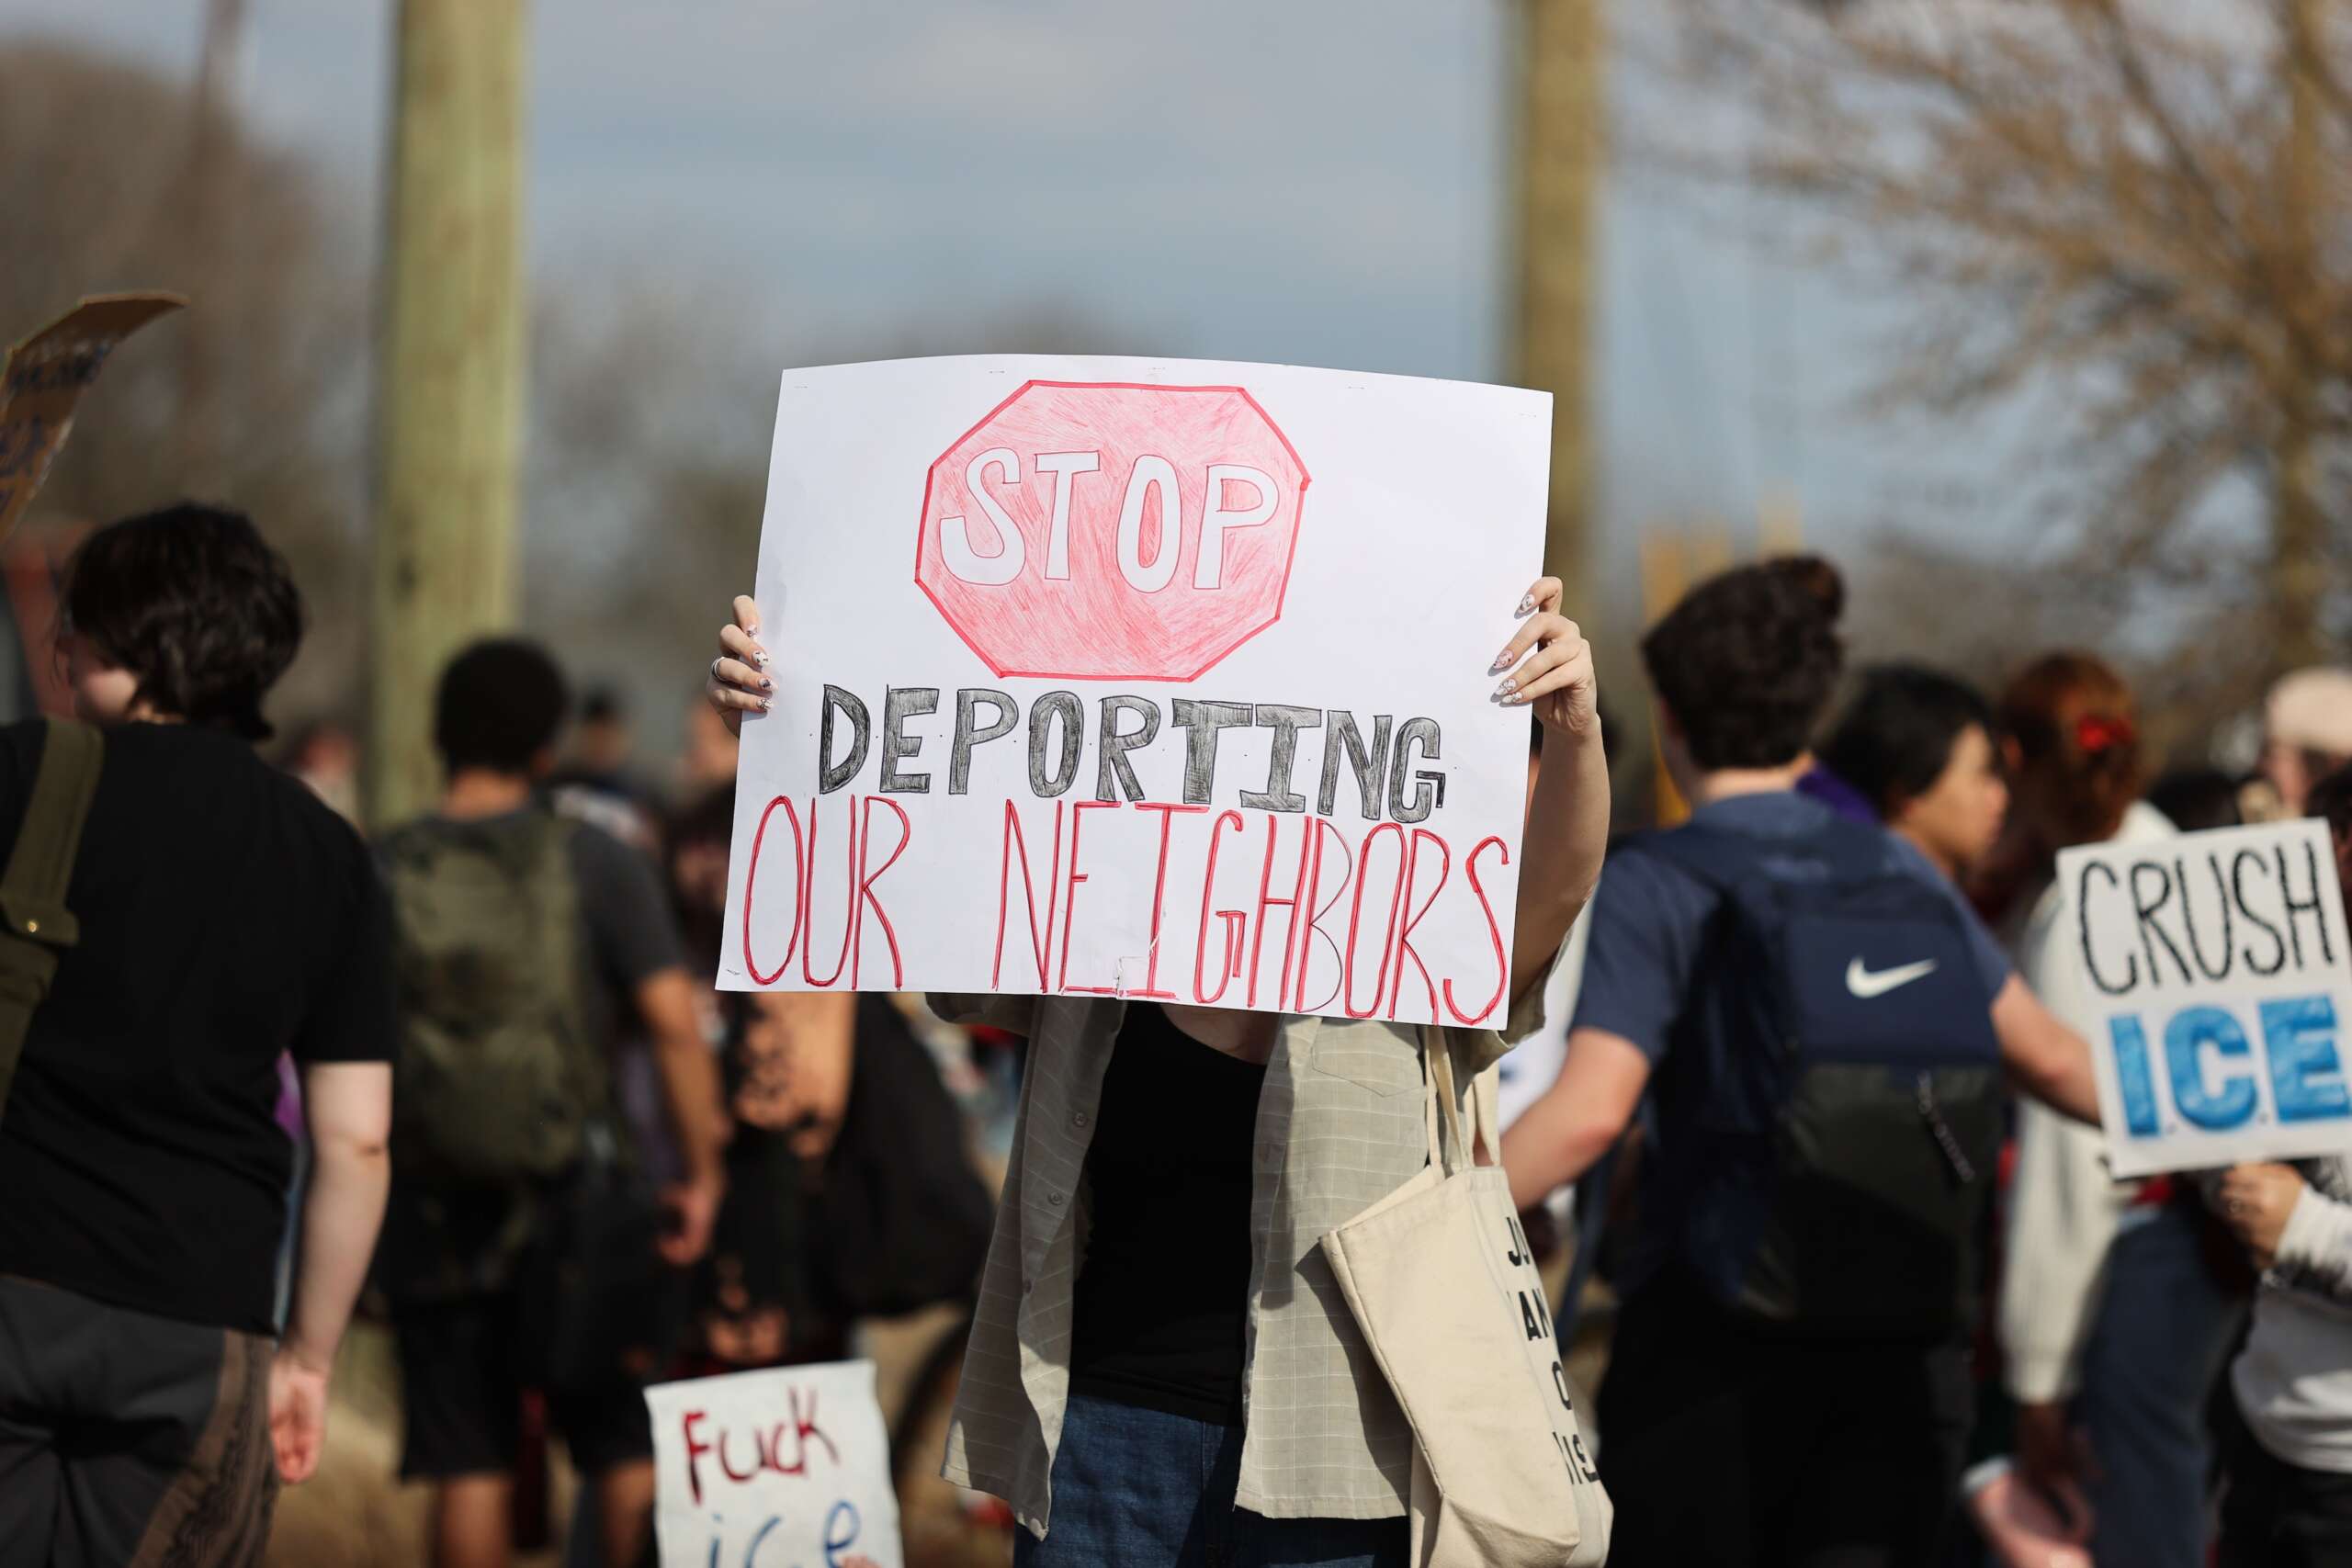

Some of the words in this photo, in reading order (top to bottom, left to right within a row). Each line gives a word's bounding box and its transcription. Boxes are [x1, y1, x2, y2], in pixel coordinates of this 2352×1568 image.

[939, 446, 1280, 594] STOP
[819, 683, 1446, 824] DEPORTING
[742, 795, 911, 991] OUR
[991, 796, 1510, 1026] NEIGHBORS
[2079, 839, 2335, 995] CRUSH
